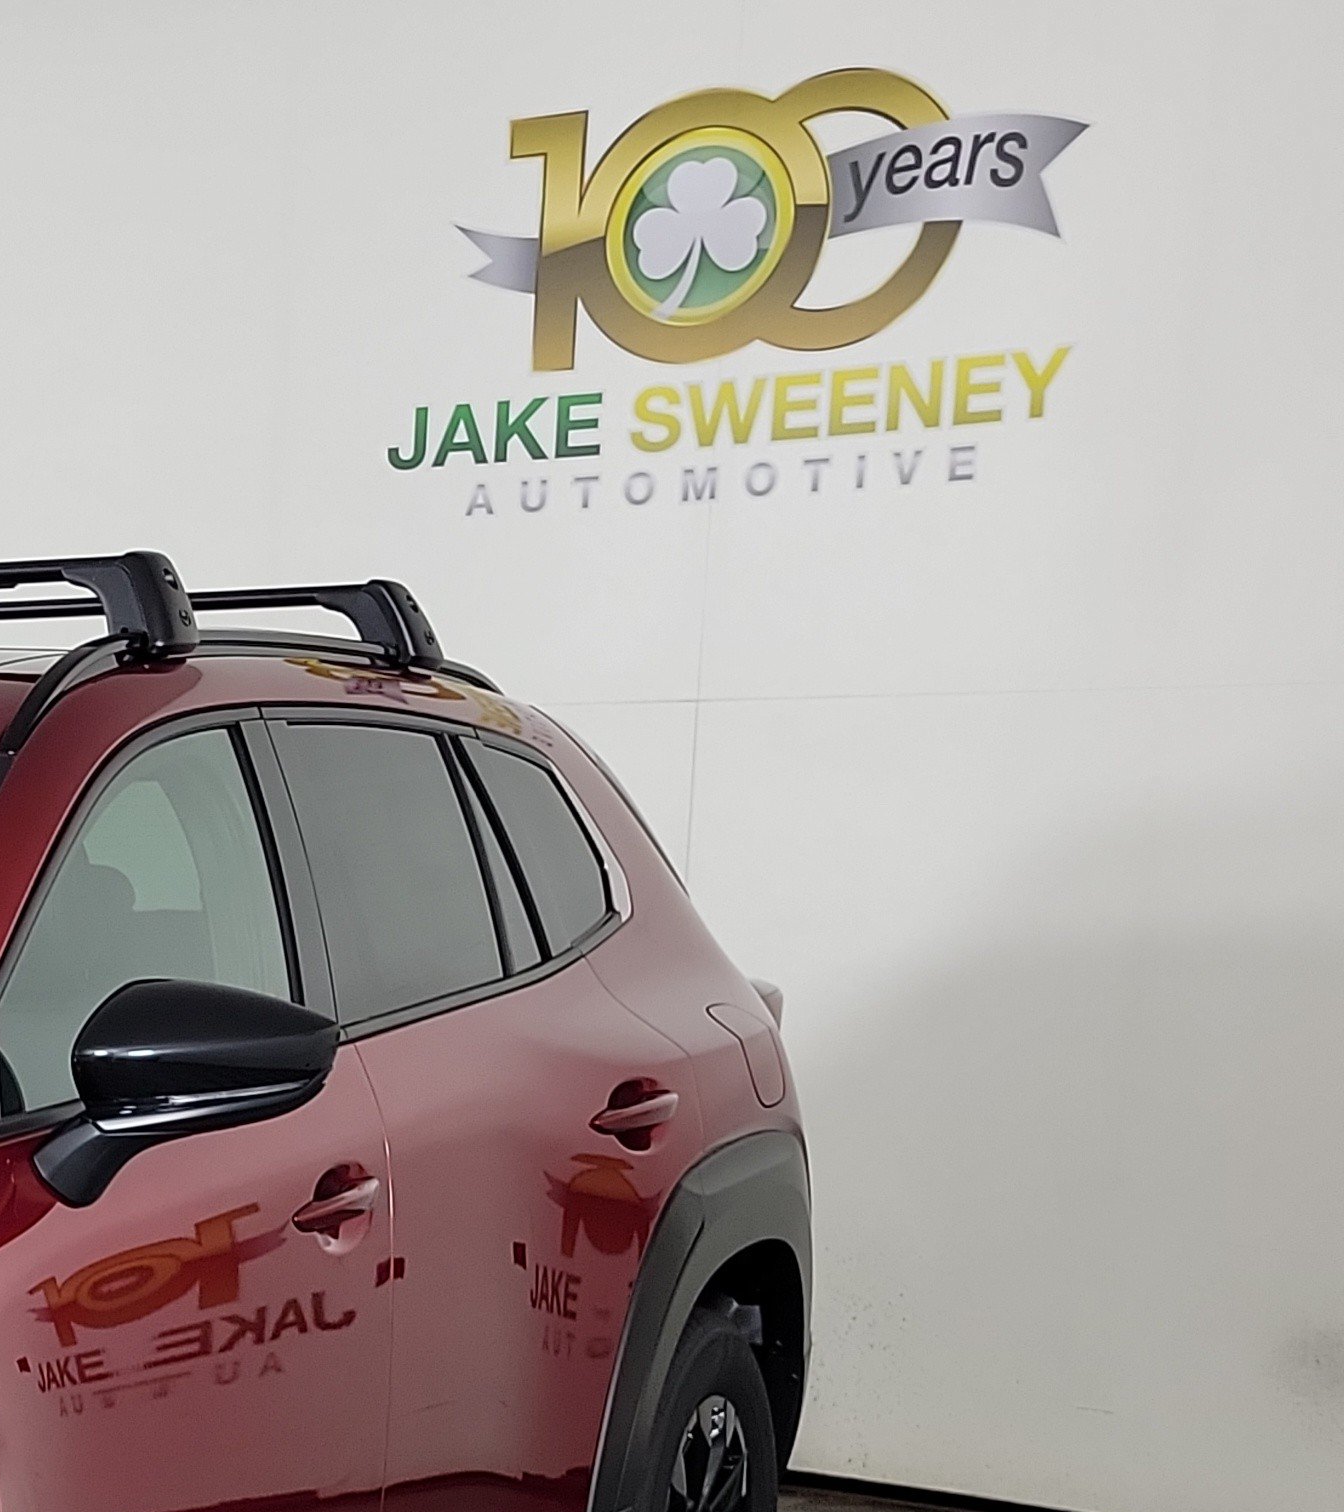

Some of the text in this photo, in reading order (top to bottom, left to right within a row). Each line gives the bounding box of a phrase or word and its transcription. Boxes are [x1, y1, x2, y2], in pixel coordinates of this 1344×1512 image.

[511, 66, 1029, 372] 100 years
[387, 345, 1072, 471] JAKE SWEENEY
[464, 445, 978, 517] AUTOMOTIVE
[528, 1262, 582, 1322] JAKE
[36, 1349, 115, 1394] JAKE
